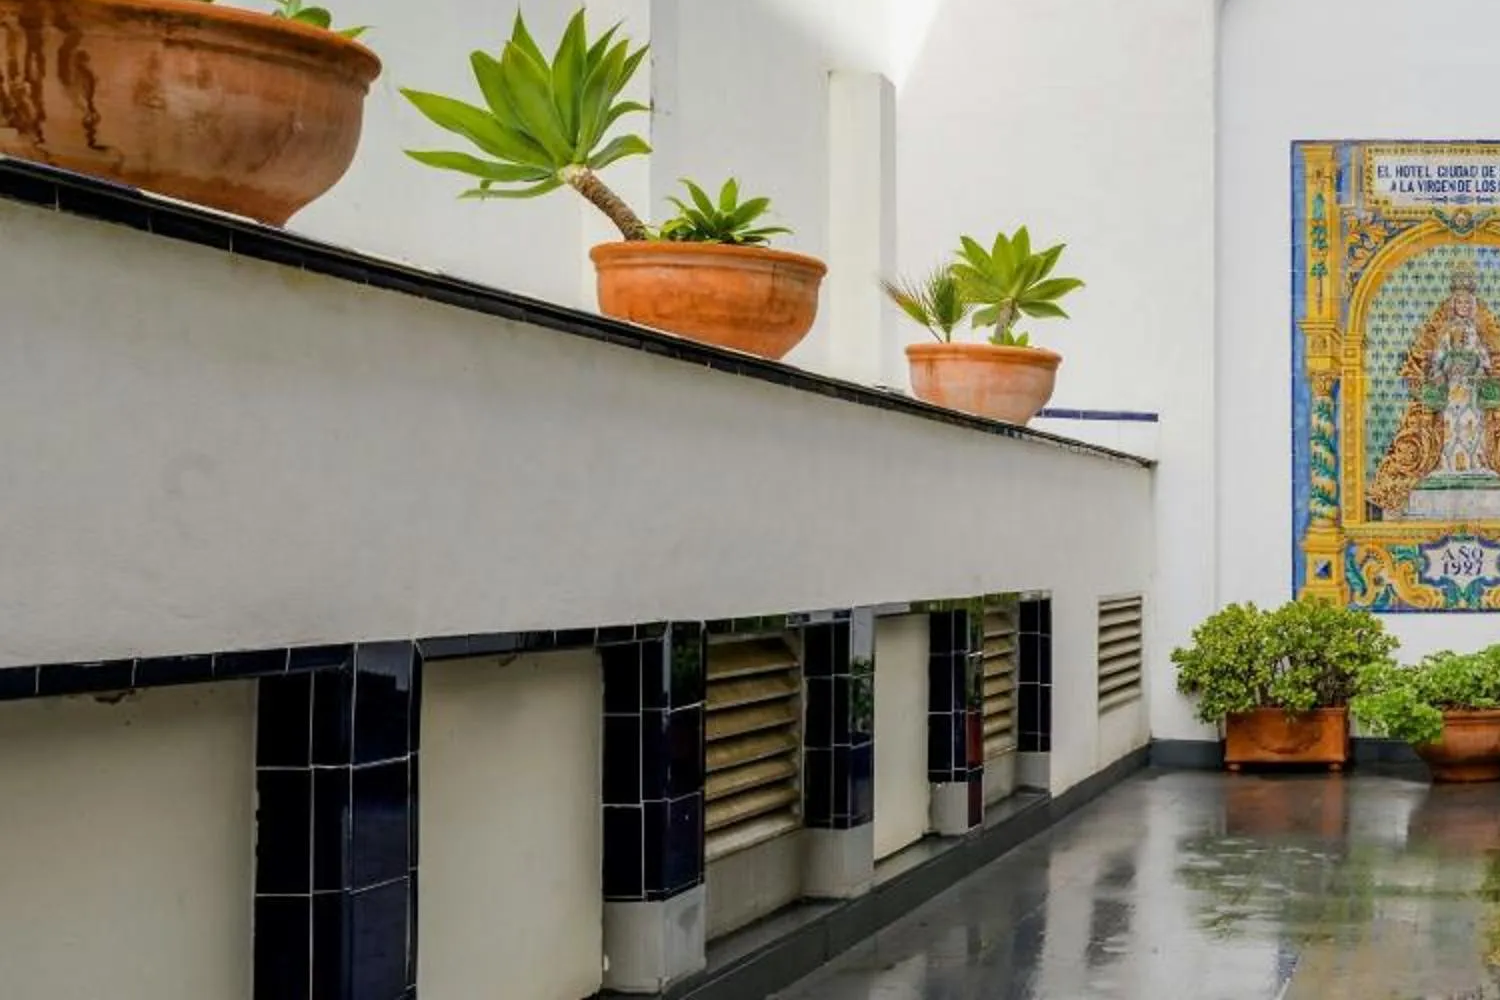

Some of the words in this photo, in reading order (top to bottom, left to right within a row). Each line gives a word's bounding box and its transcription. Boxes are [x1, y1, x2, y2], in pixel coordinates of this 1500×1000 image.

[1377, 165, 1391, 178] EL
[1395, 165, 1431, 178] HOTEL
[1437, 165, 1478, 178] CIUDAD
[1482, 165, 1497, 178] DE
[1476, 180, 1497, 192] LOS
